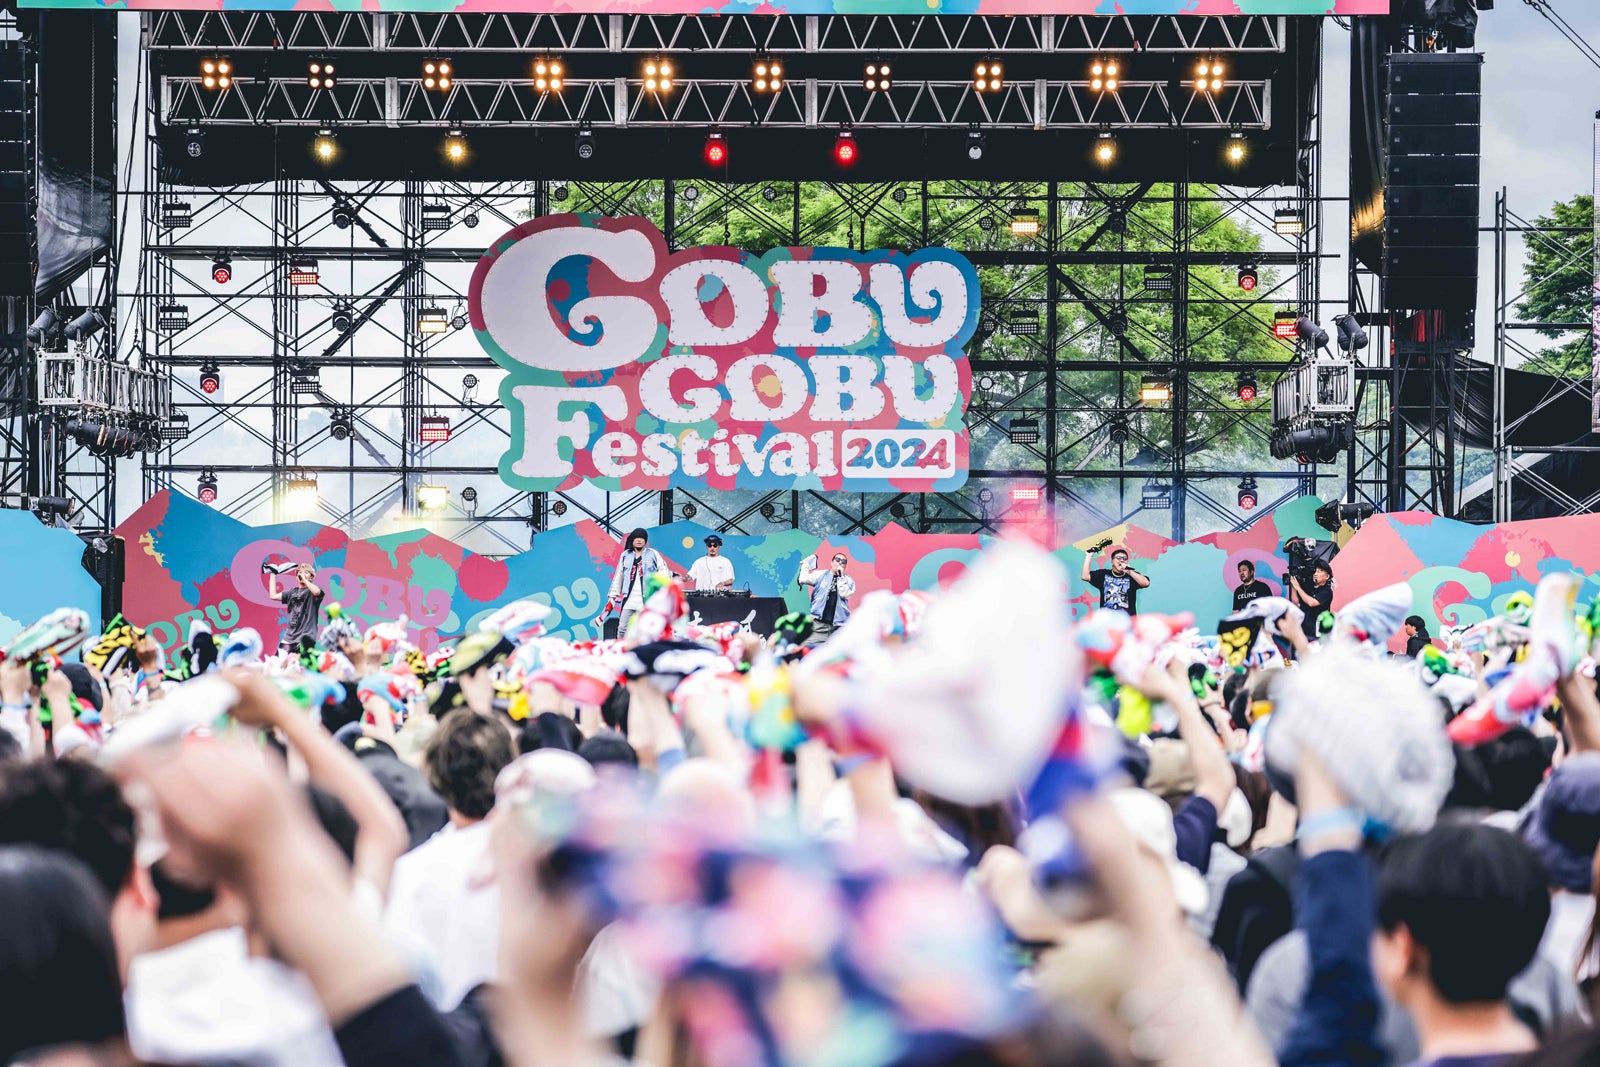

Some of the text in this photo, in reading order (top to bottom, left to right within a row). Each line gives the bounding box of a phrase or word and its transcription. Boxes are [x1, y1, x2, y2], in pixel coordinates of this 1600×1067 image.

[481, 226, 967, 372] GOBU
[639, 354, 958, 422] GOBU
[511, 385, 950, 477] Festival 2024
[231, 539, 452, 627] GOBU
[1237, 591, 1257, 600] CELINE
[128, 599, 240, 650] OBU
